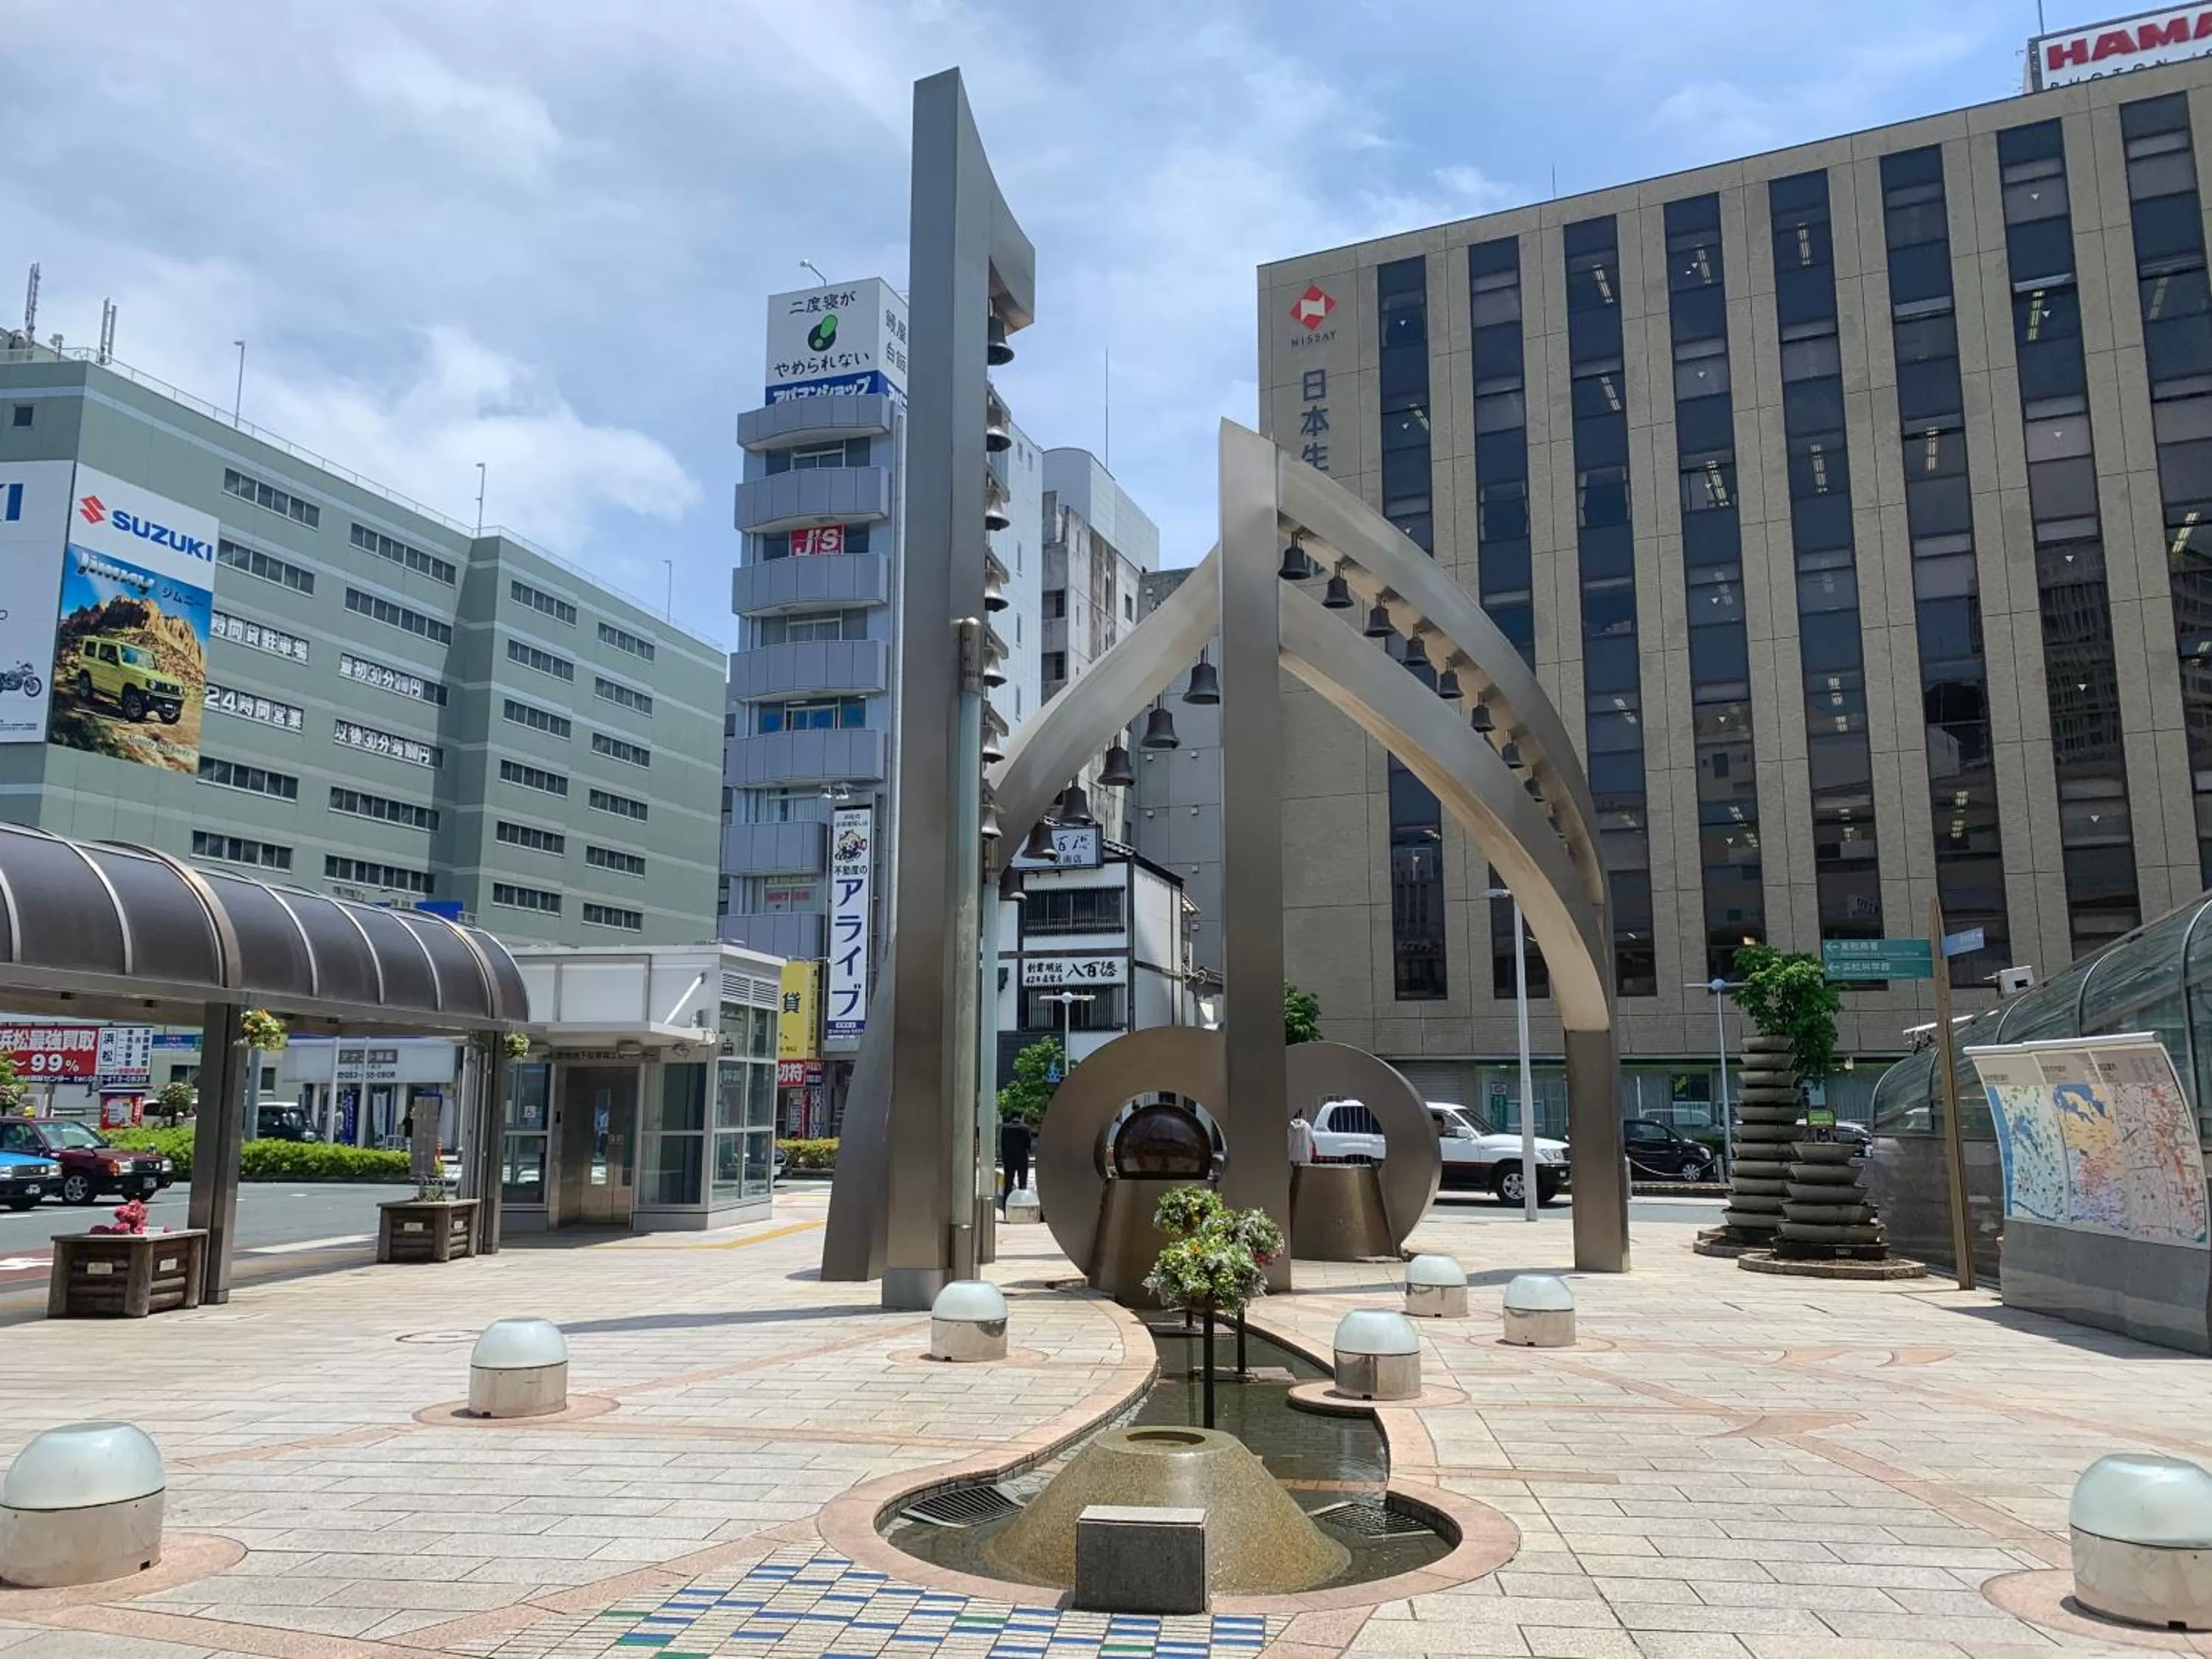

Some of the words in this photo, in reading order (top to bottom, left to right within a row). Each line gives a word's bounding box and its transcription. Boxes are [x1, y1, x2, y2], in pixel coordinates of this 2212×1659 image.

[790, 291, 857, 314] 二度寝が
[1291, 330, 1337, 348] NISSAY
[775, 353, 869, 378] やめられない
[111, 509, 213, 562] SUZUKI
[832, 880, 863, 1017] アライブ
